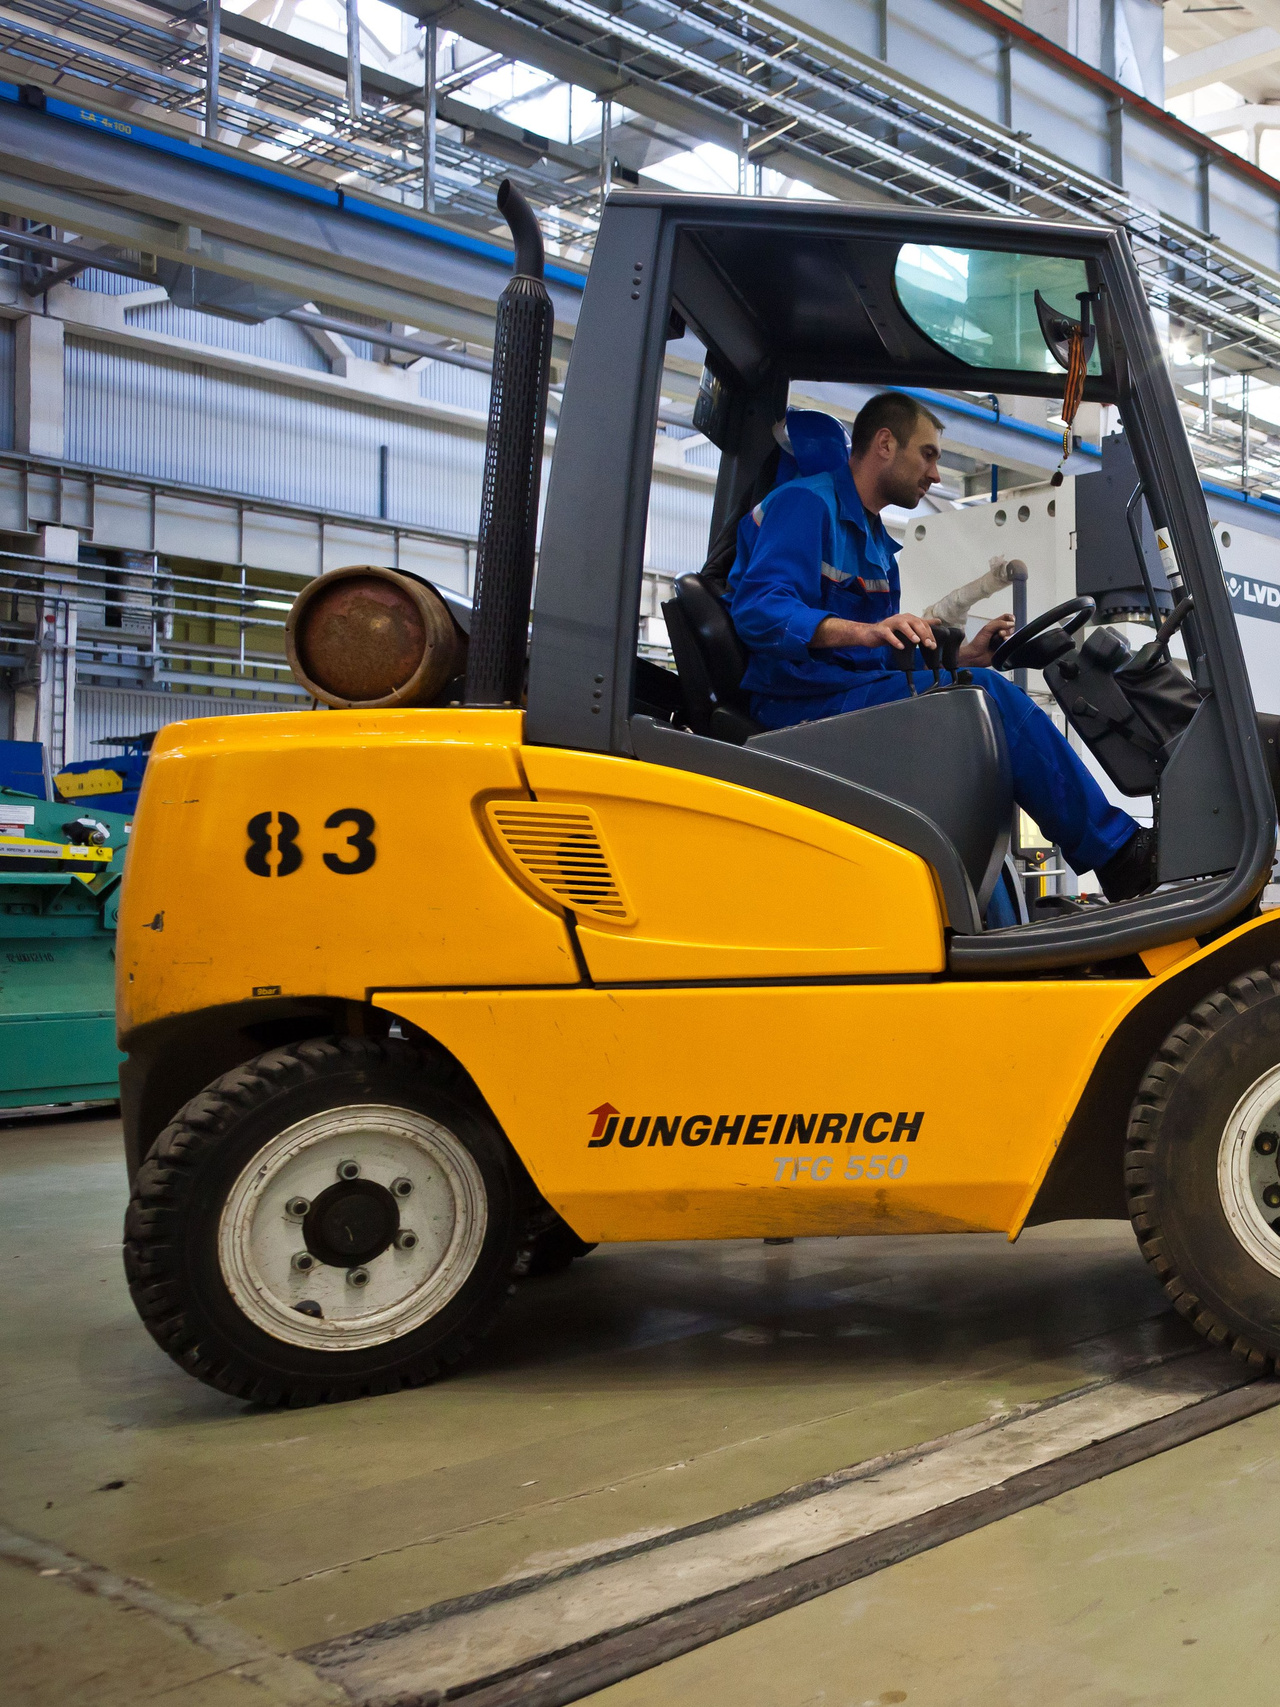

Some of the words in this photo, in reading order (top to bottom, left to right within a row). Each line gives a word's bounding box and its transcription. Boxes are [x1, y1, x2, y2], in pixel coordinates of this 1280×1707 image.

[587, 1111, 925, 1149] JUNGHEINRICH
[773, 1155, 834, 1182] TFG
[843, 1154, 909, 1181] 550
